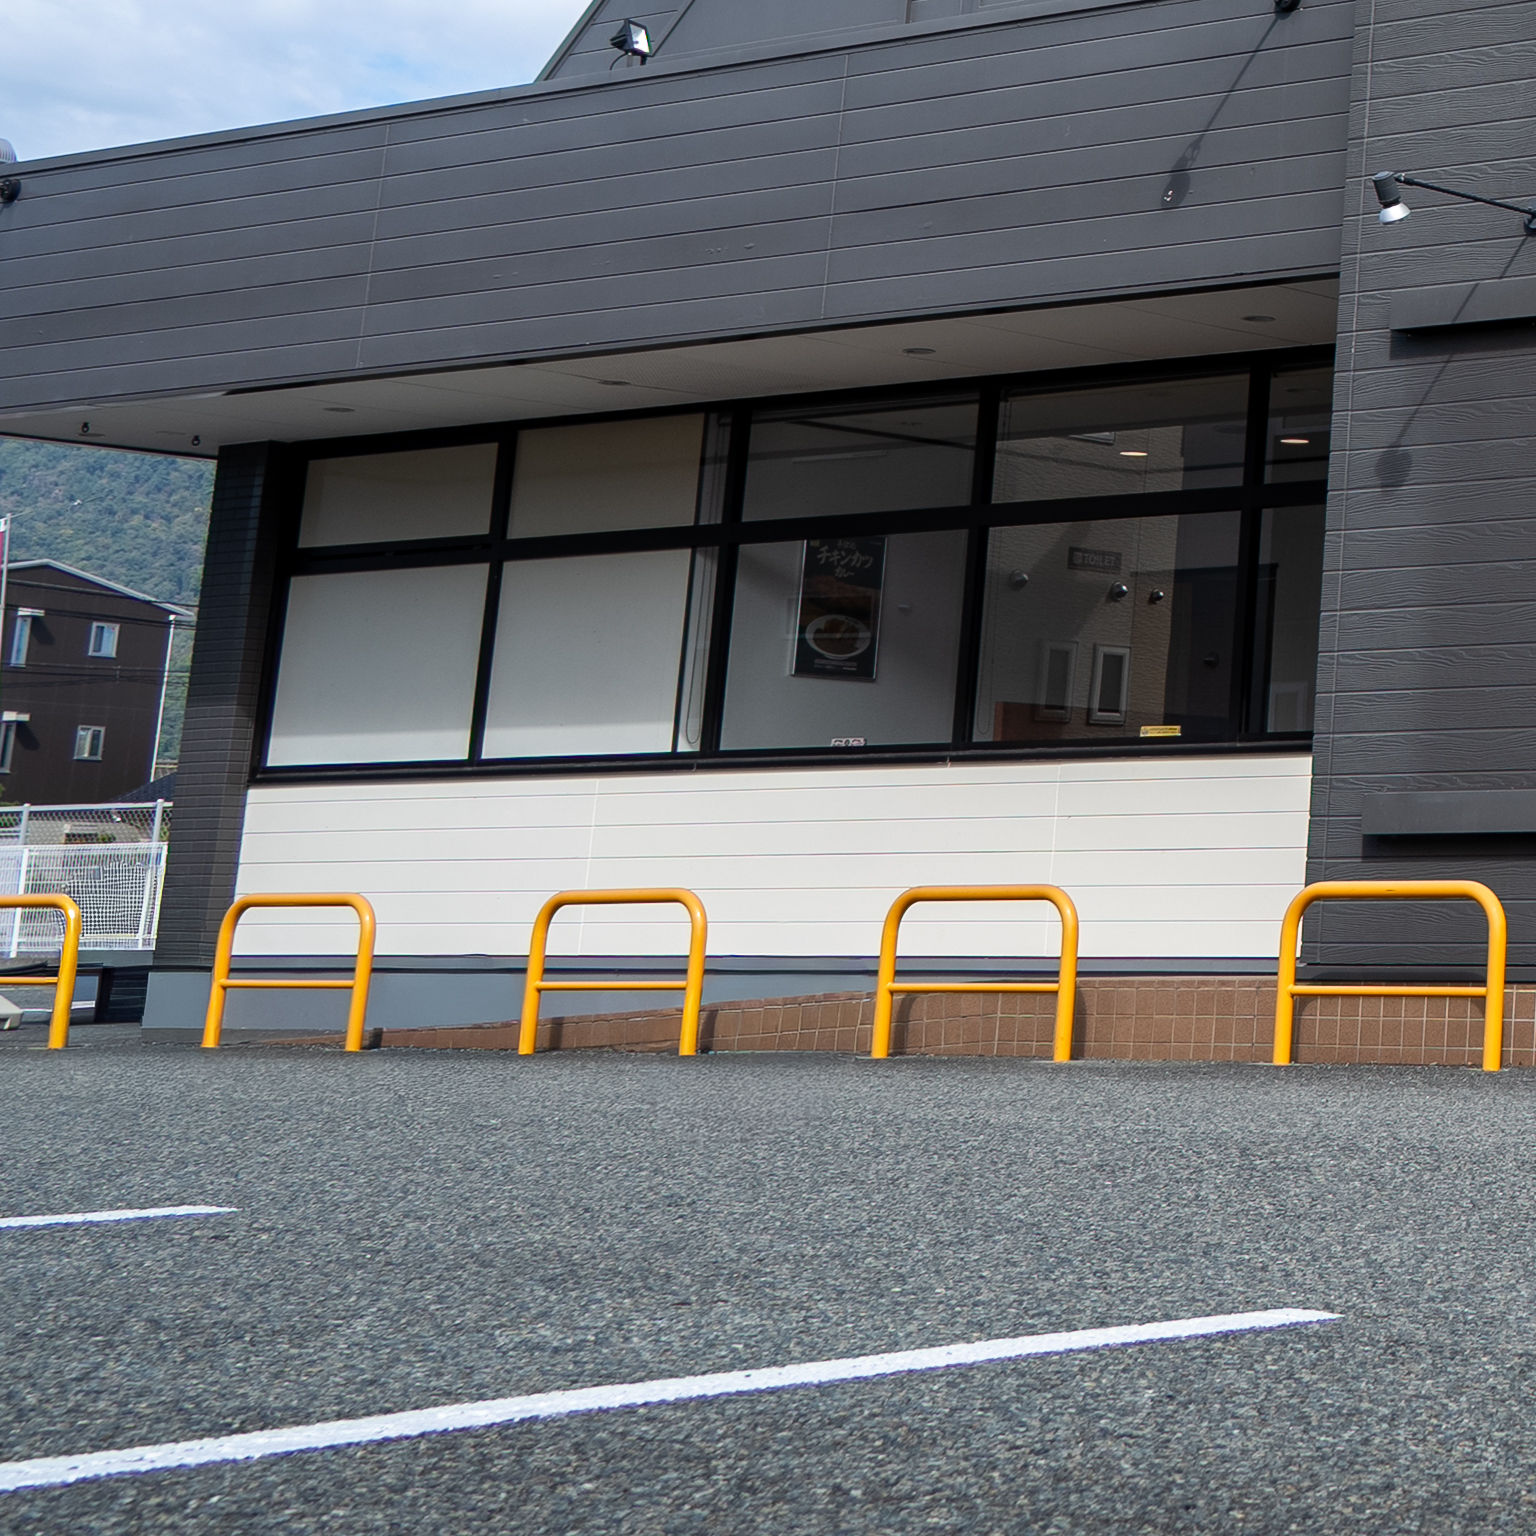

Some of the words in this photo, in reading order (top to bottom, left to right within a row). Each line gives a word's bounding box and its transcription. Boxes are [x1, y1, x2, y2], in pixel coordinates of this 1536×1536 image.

[817, 545, 874, 568] チキンカツ
[1083, 553, 1116, 567] TOILET
[835, 566, 855, 578] カレー
